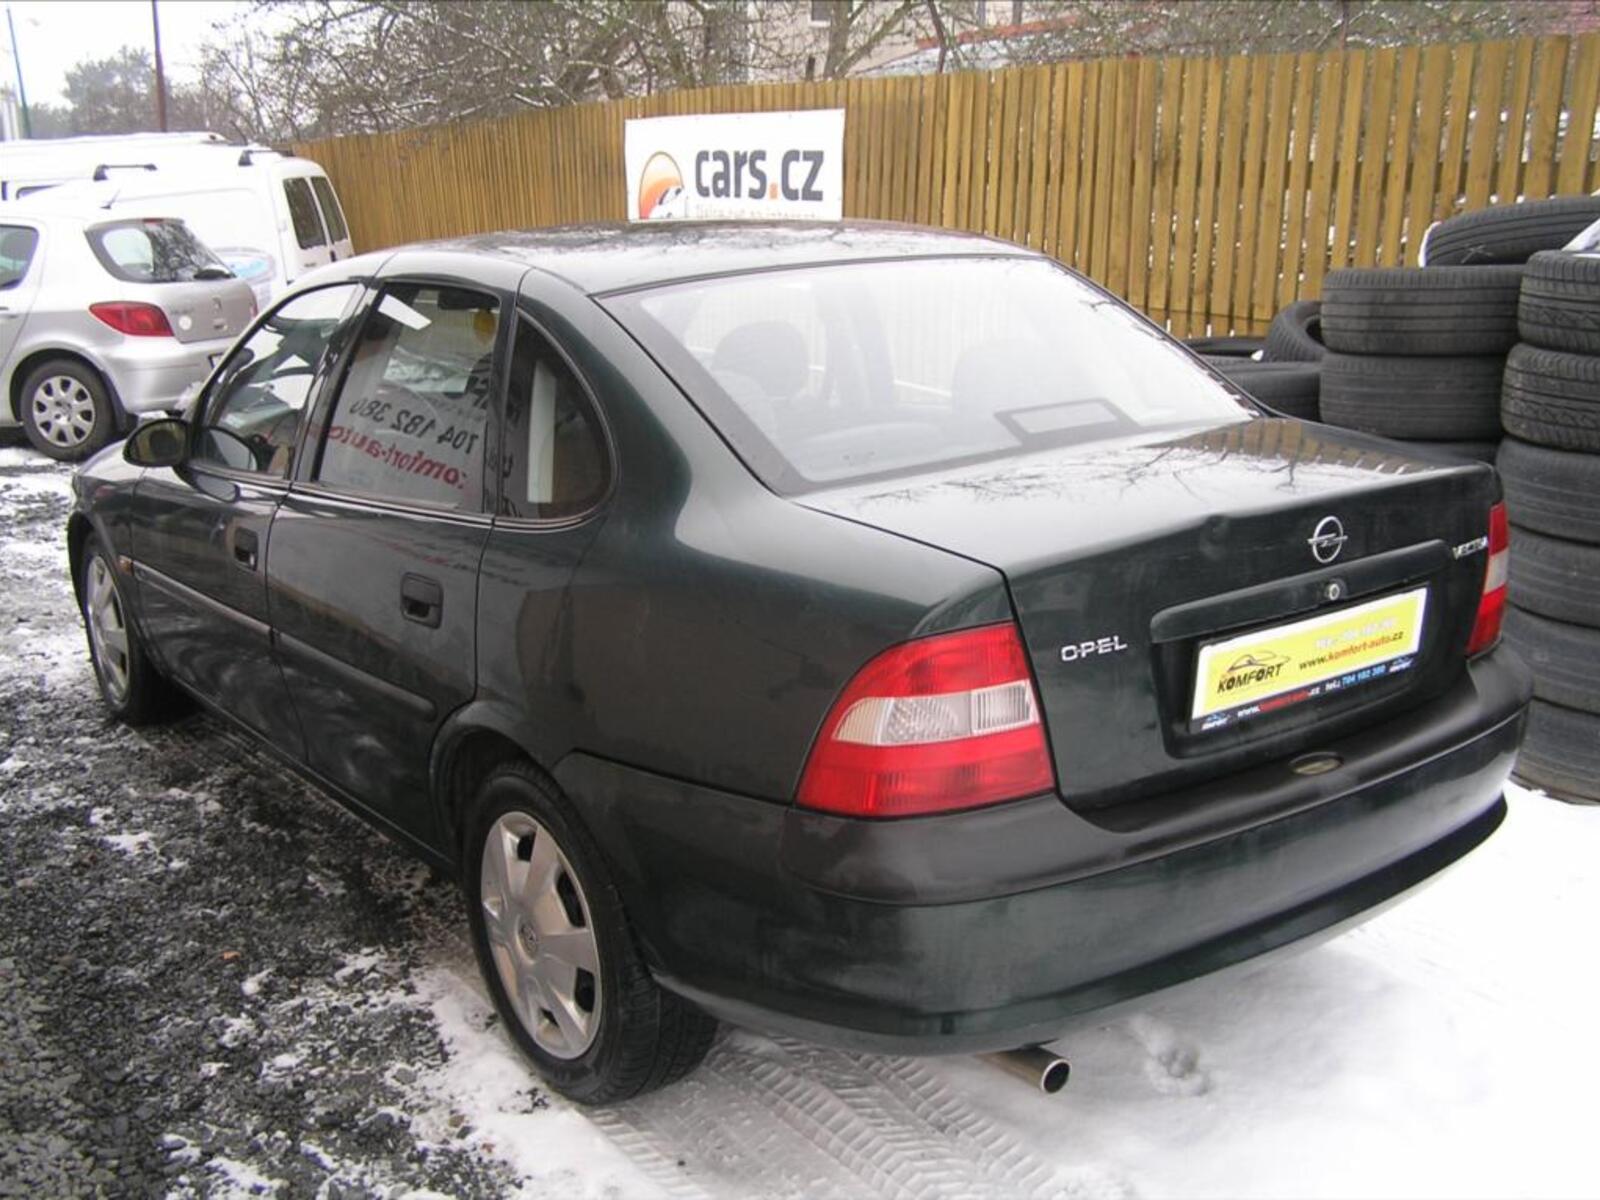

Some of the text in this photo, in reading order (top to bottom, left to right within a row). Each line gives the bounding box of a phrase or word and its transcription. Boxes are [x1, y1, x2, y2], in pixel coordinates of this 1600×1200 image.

[695, 148, 825, 202] cars.cz
[1061, 635, 1128, 661] OPEL
[1299, 630, 1404, 669] www.komfort-auto.cz
[1216, 663, 1285, 694] KOMFORT
